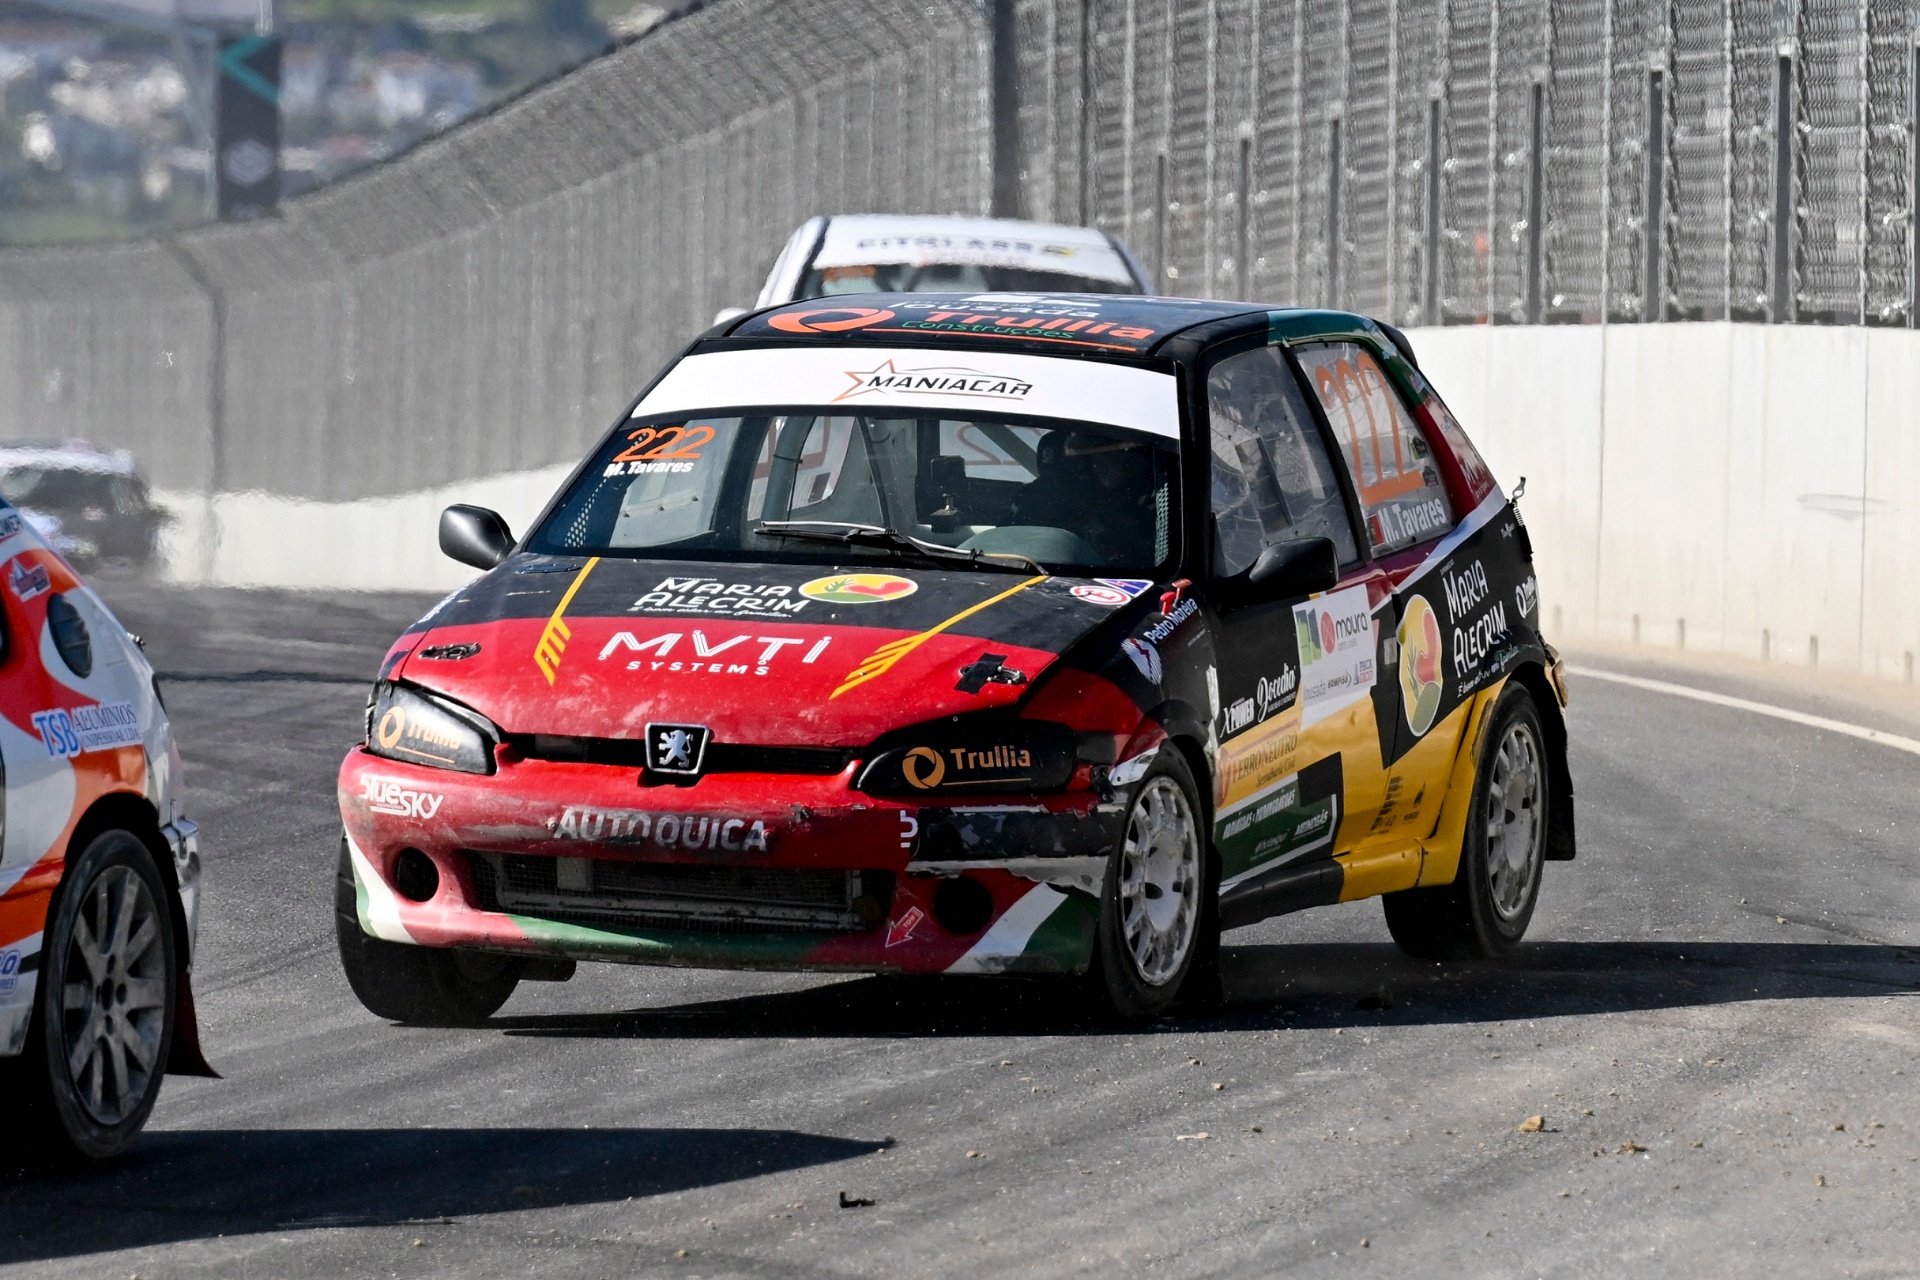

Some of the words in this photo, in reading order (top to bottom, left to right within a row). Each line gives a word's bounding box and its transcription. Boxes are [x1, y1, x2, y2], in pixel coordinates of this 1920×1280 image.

[888, 302, 1100, 318] lousada
[901, 320, 1076, 339] Construções
[925, 311, 1155, 340] Trullia
[867, 374, 1034, 396] MANIACAR
[612, 426, 716, 463] 222
[653, 579, 793, 596] MARIA
[1442, 559, 1490, 625] MARIA
[634, 592, 811, 612] ALECRIM
[1143, 620, 1175, 644] Pedro
[1164, 598, 1198, 627] Moreira
[1336, 611, 1368, 639] moura
[597, 630, 832, 664] MVTI
[1453, 600, 1512, 678] ALECRIM
[626, 661, 769, 675] SYSTEMS
[35, 711, 79, 756] TSB
[950, 745, 1031, 770] Trullia
